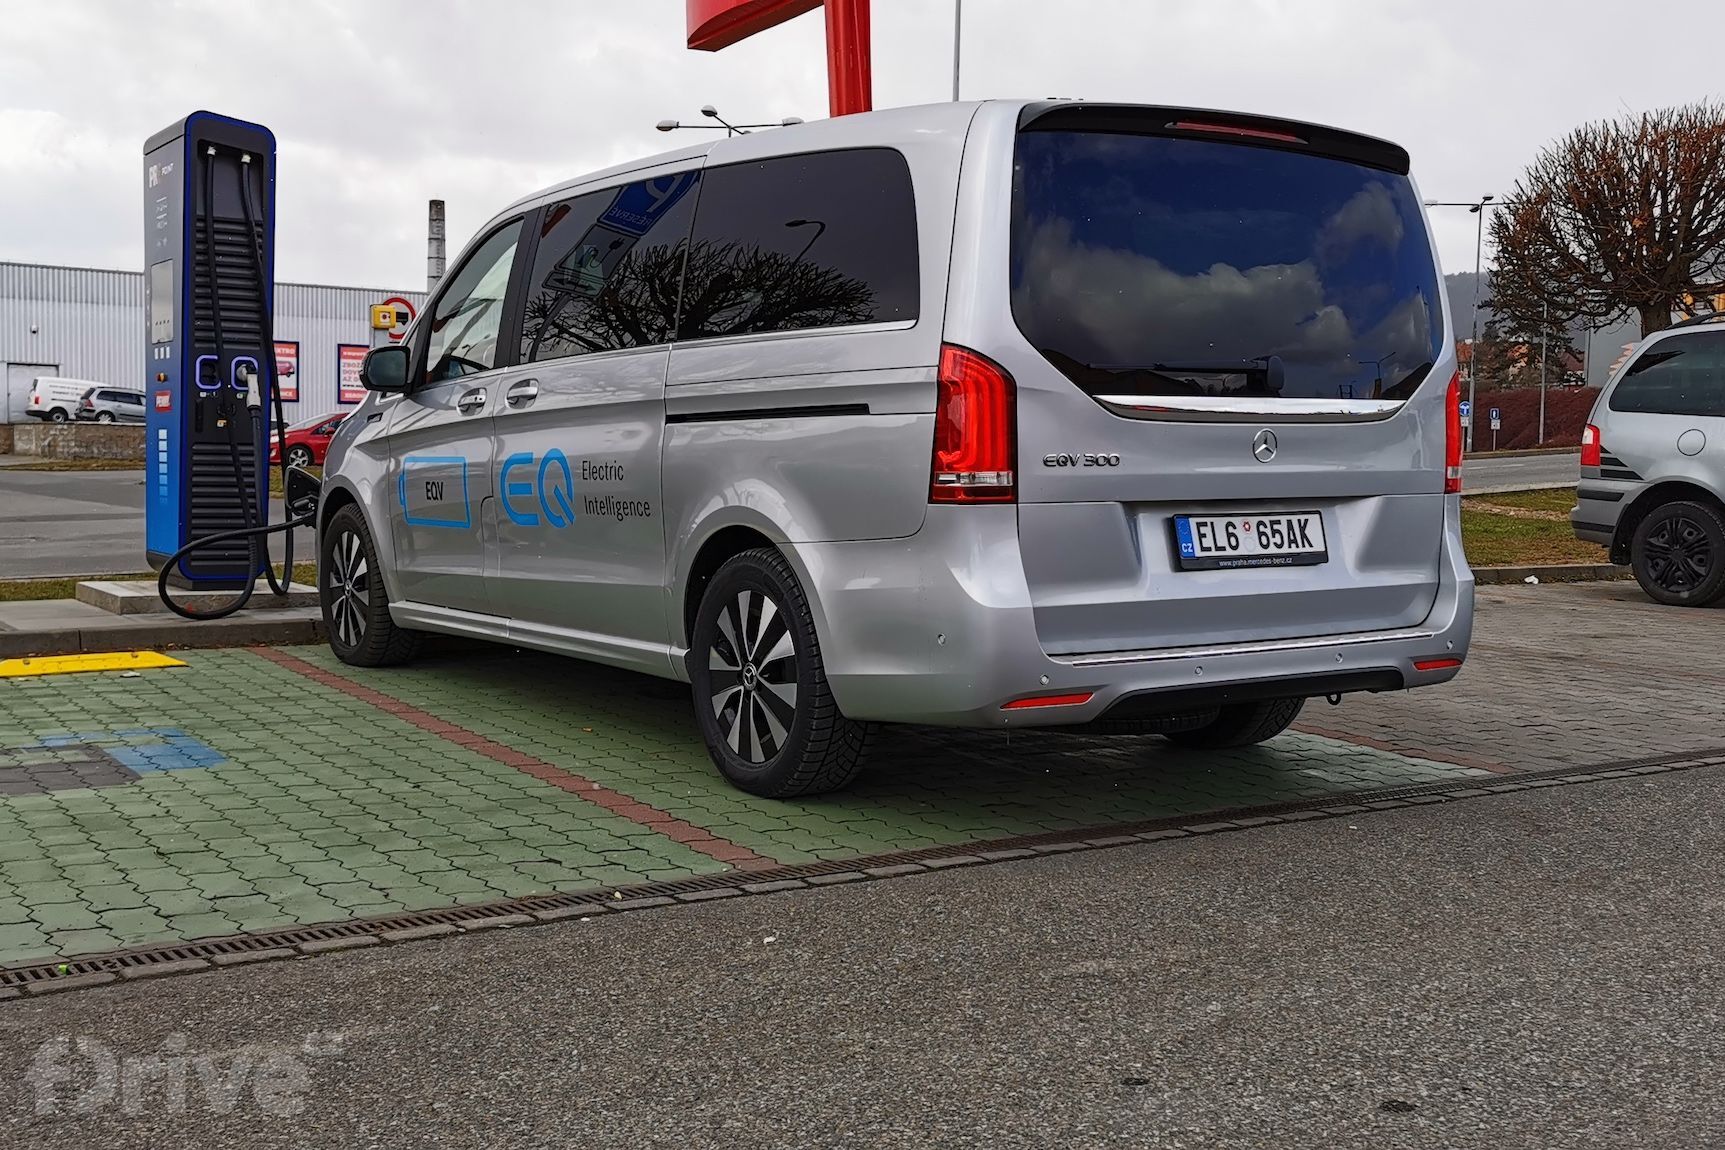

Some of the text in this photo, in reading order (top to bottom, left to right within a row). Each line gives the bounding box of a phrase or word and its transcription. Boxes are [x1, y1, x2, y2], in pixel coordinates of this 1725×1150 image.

[582, 460, 624, 481] Electric
[1042, 453, 1120, 468] EQV 300
[425, 481, 444, 501] EQV
[584, 495, 651, 522] Intelligence
[1196, 518, 1313, 552] EL6 65AK
[1181, 542, 1193, 553] CZ
[1219, 557, 1293, 568] www.praha.mercedes-benz.cz
